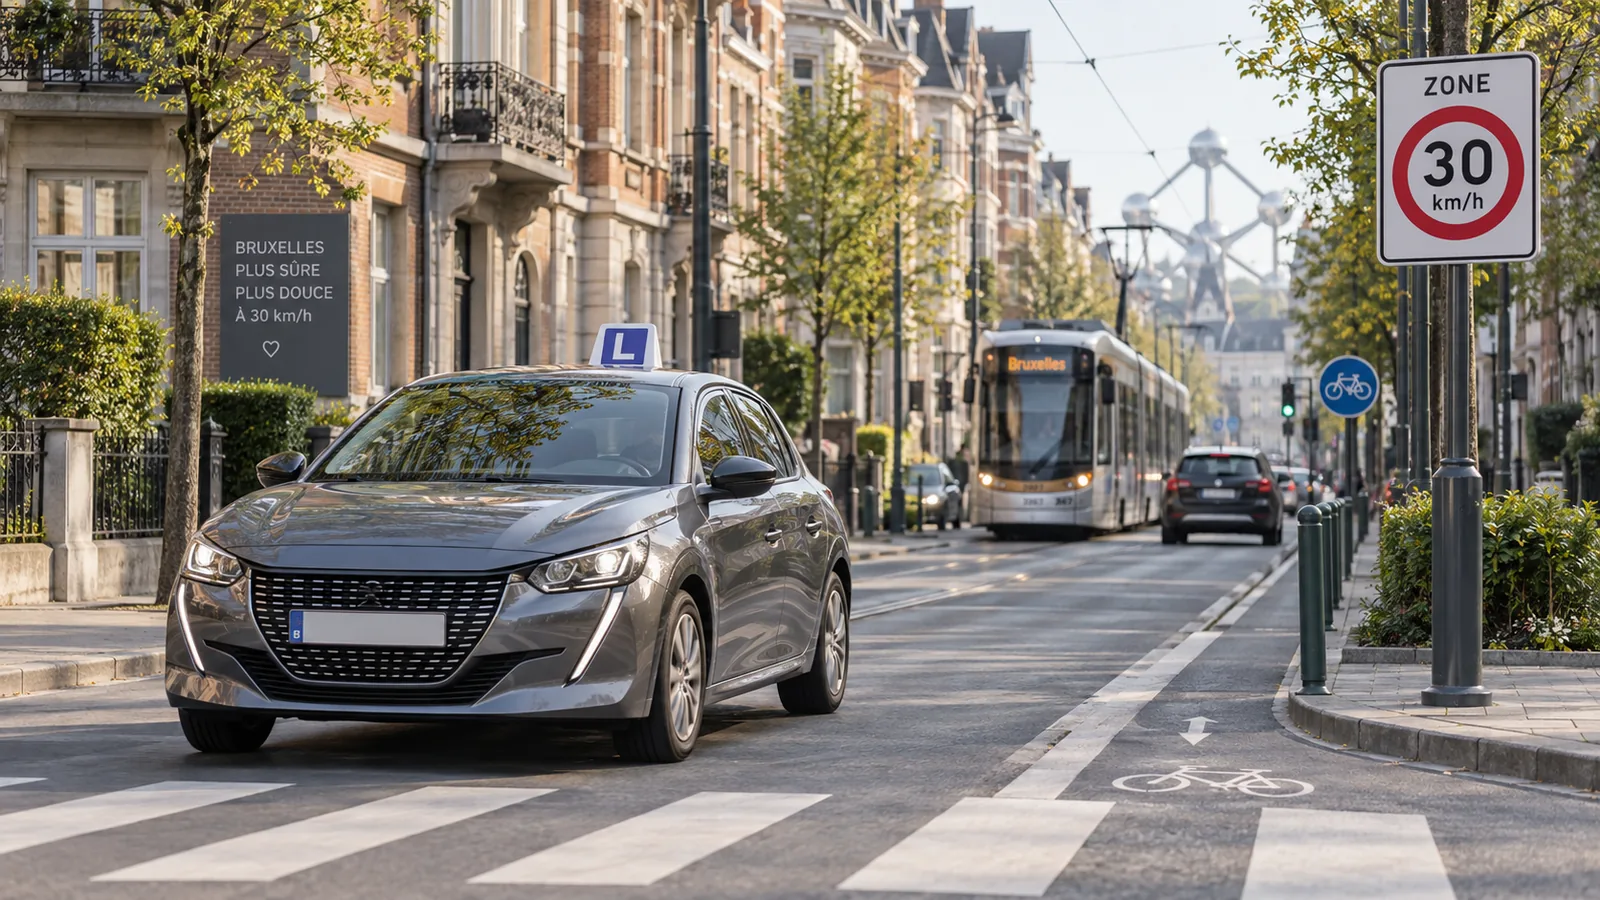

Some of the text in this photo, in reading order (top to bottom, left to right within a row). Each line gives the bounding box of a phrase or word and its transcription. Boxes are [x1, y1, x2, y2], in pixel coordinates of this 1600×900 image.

[1424, 73, 1491, 96] ZONE
[1423, 138, 1492, 187] 30
[1432, 192, 1483, 211] km/h
[235, 240, 325, 254] BRUXELLES
[235, 259, 321, 277] PLUS SÛRE
[235, 286, 333, 300] PLUS DOUCE
[235, 305, 312, 323] À 30 km/h
[612, 332, 635, 360] L
[1008, 355, 1066, 371] Bruxelles
[293, 629, 301, 639] B
